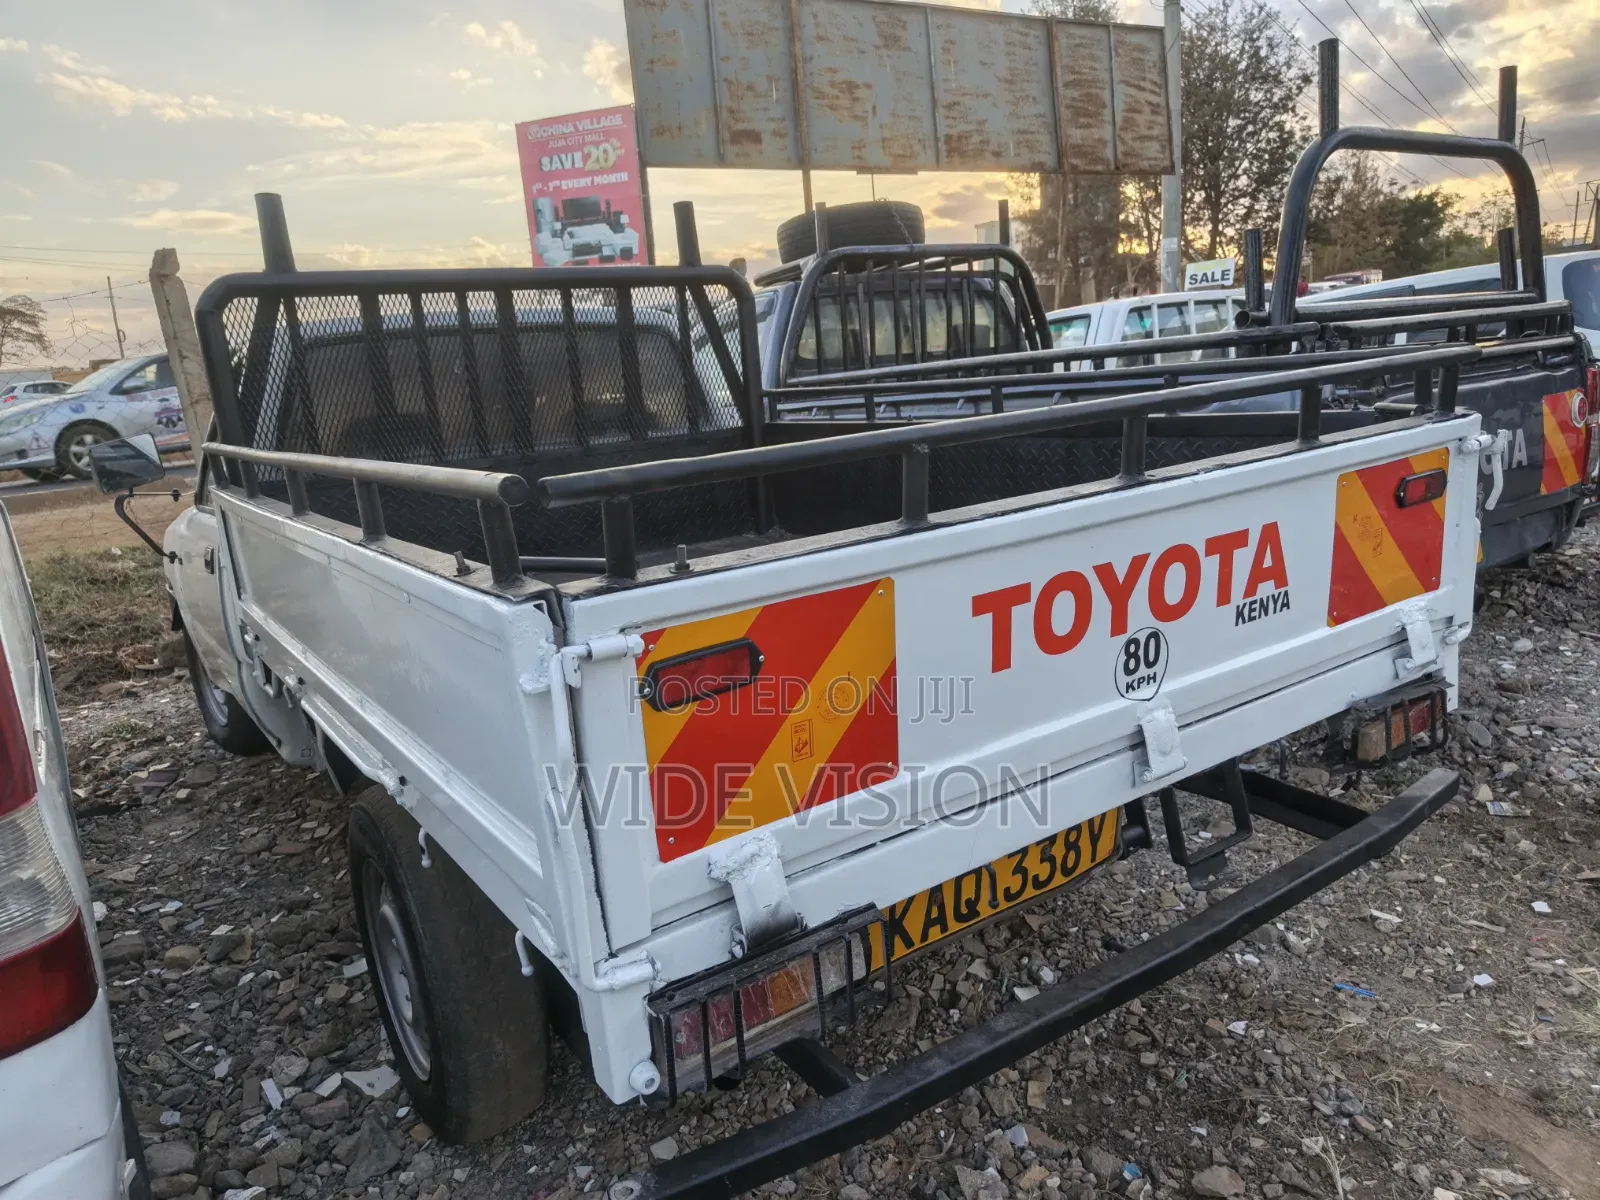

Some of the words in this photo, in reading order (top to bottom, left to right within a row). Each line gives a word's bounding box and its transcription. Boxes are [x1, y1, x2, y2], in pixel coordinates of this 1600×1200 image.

[540, 122, 575, 137] CHINA
[576, 113, 623, 131] VILLAGE
[567, 135, 583, 146] CITY
[584, 132, 605, 143] MALL
[540, 151, 583, 172] SAVE
[561, 176, 592, 190] EVERY
[593, 171, 628, 186] MONTH
[1188, 268, 1231, 285] SALE
[972, 521, 1288, 673] TOYOTA
[1235, 590, 1290, 626] KENYA
[1122, 630, 1161, 676] 80
[1125, 671, 1157, 694] KPH
[889, 866, 981, 958] KAQ
[1003, 812, 1106, 903] 338Y
